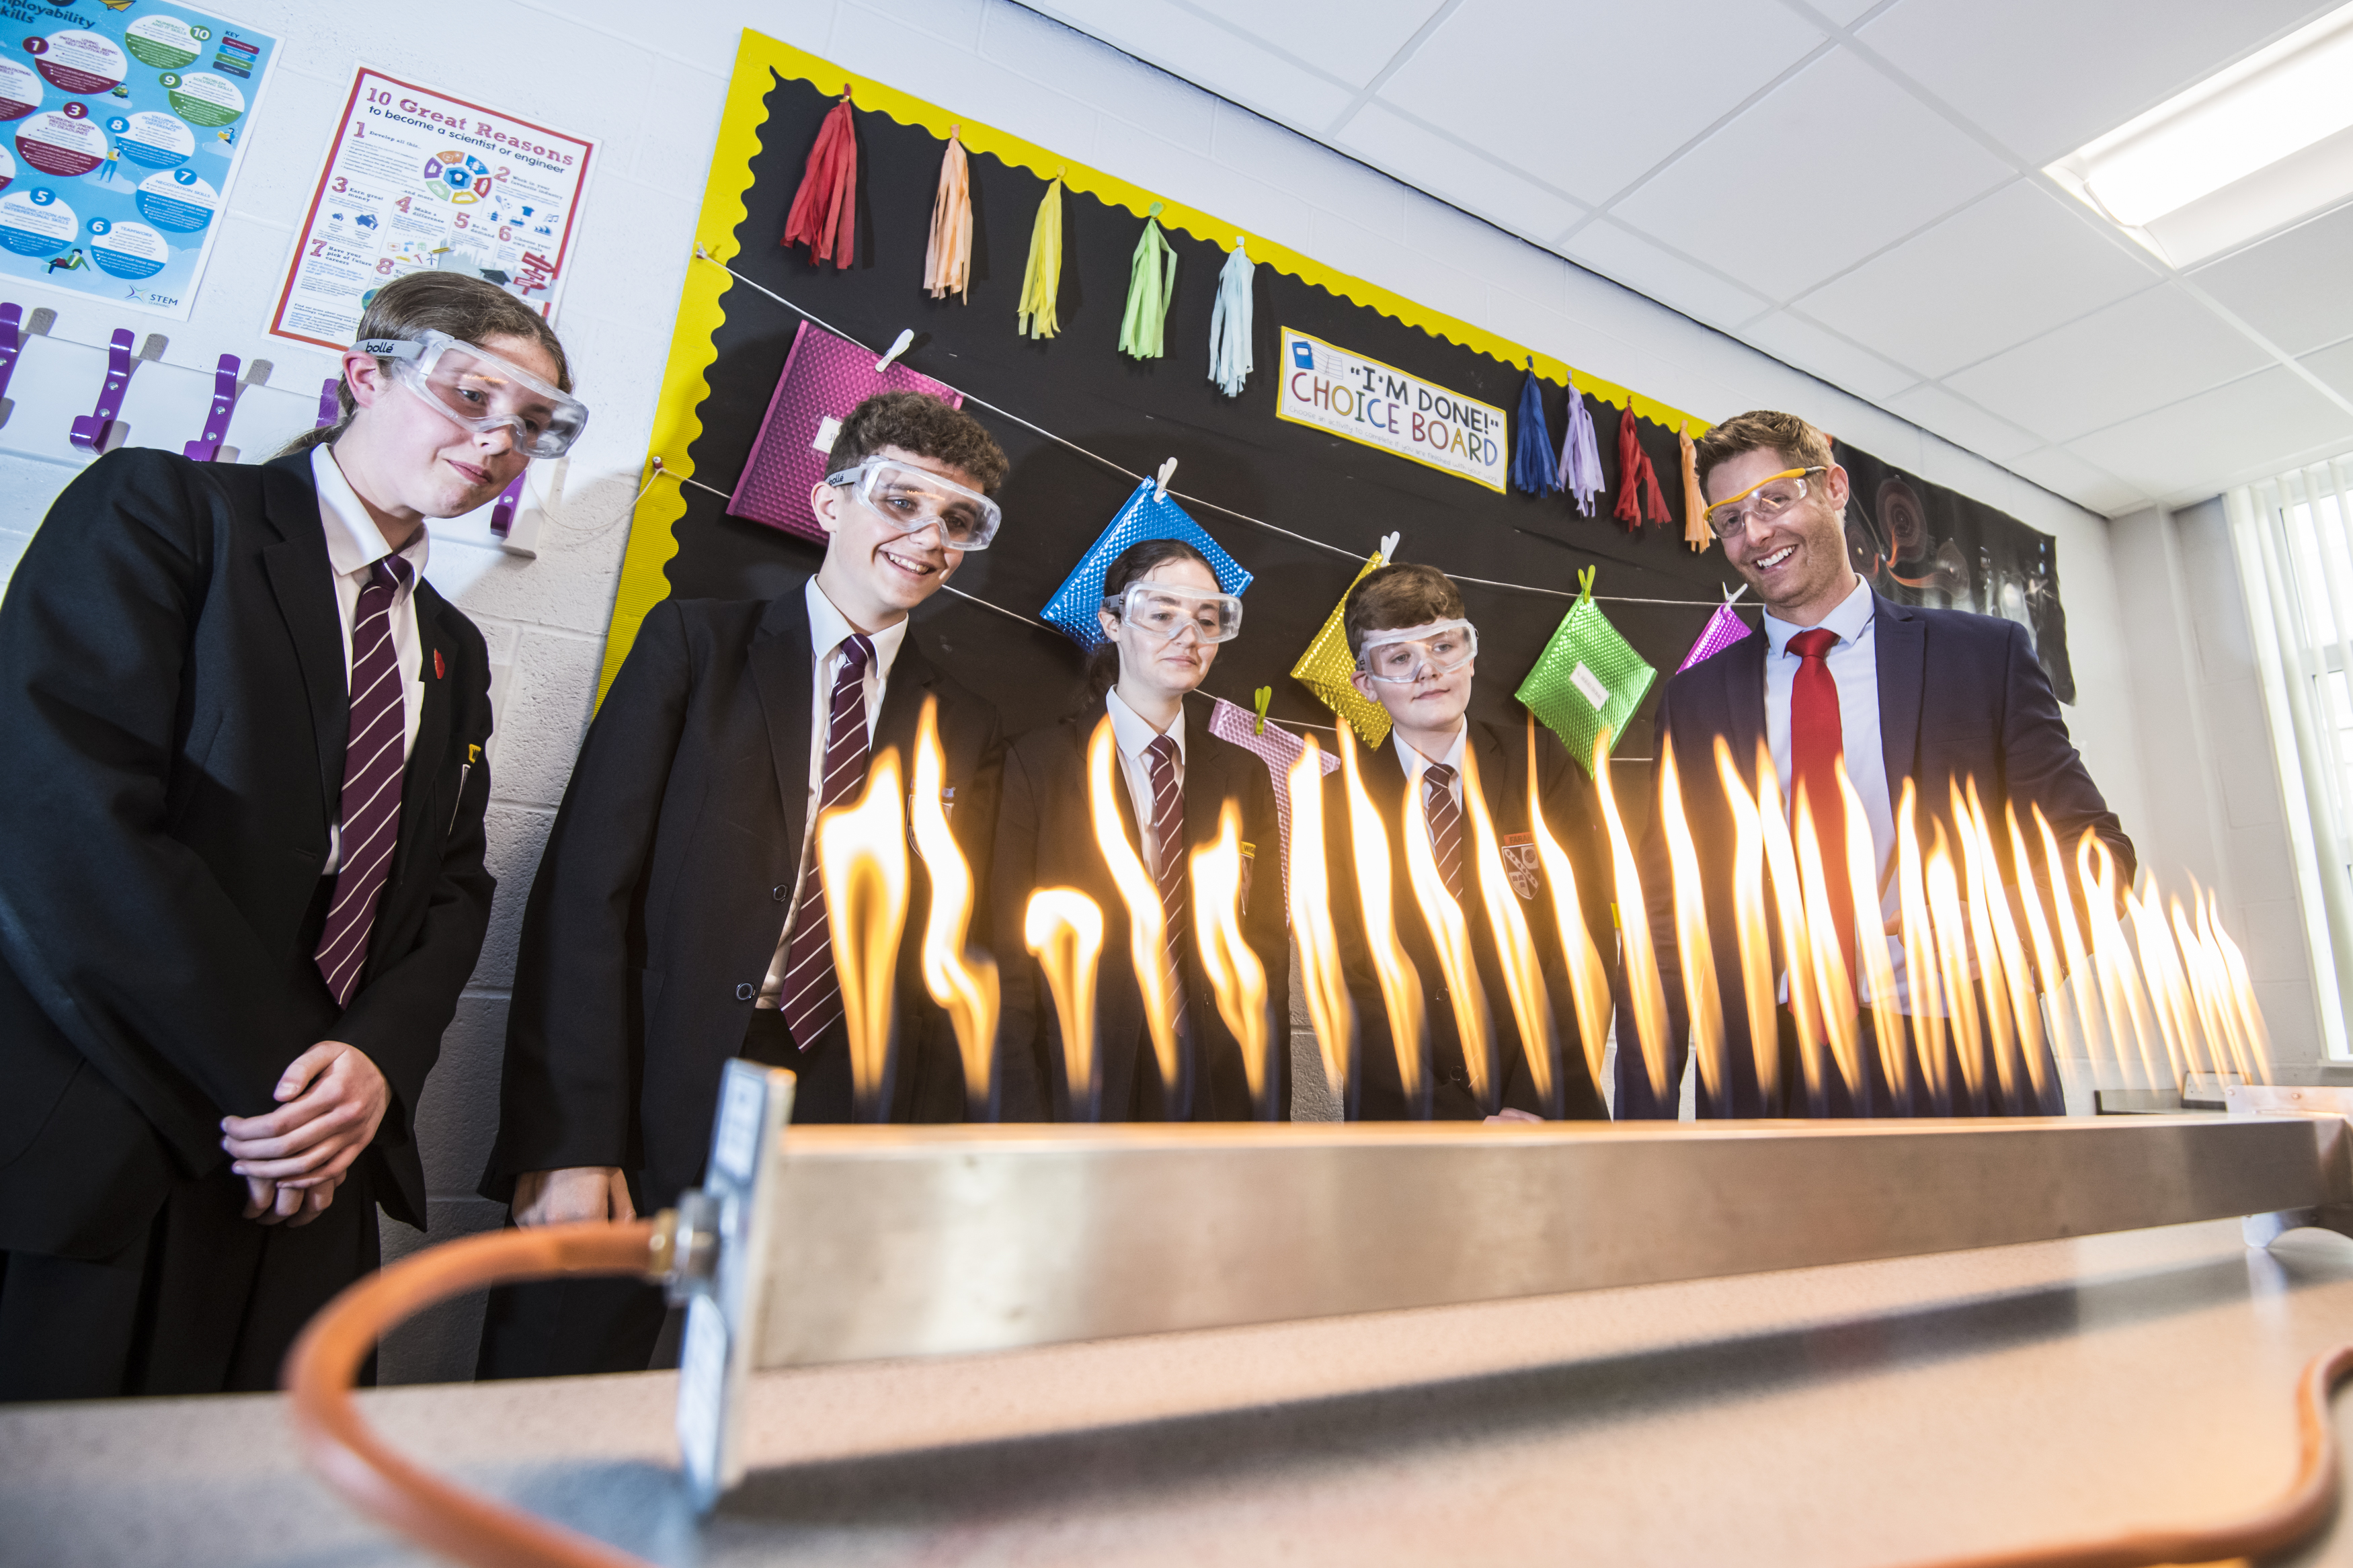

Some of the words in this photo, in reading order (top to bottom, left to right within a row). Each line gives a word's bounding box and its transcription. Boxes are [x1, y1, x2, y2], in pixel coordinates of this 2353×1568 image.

[156, 19, 184, 30] NUMERACY
[194, 28, 209, 39] 10
[30, 40, 40, 52] 1
[59, 36, 87, 46] INITIATIVE
[66, 41, 109, 56] SELF-MOTIVATED
[164, 75, 175, 85] 9
[194, 77, 216, 87] SOLVING
[202, 77, 226, 85] PROBLEM
[69, 106, 81, 116] 3
[47, 115, 73, 124] WORKING
[50, 119, 75, 128] PRESSURE
[112, 120, 123, 130] 8
[143, 116, 169, 126] DIVERSITY
[152, 115, 175, 124] VALUING
[58, 125, 87, 136] DEADLINES
[145, 121, 175, 132] DIFFERENCE
[354, 122, 364, 138] 1
[367, 88, 391, 106] 10
[400, 99, 466, 130] Great
[476, 123, 572, 165] Reasons
[370, 131, 395, 141] Develop
[370, 106, 381, 115] to
[385, 110, 434, 130] become
[449, 132, 495, 150] scientist
[515, 153, 564, 173] engineer
[180, 171, 191, 181] 7
[493, 167, 510, 183] 2
[156, 180, 193, 192] NEGOTIATION
[332, 177, 348, 193] 3
[511, 181, 536, 191] favourite
[539, 190, 563, 200] industry
[36, 191, 48, 202] 5
[348, 194, 370, 202] money
[5, 202, 56, 217] COMMUNICATION
[396, 196, 411, 213] 4
[4, 206, 48, 220] INTERPERSONAL
[413, 212, 444, 223] difference
[454, 212, 470, 229] 5
[93, 221, 104, 232] 6
[121, 226, 152, 237] TEAMWORK
[471, 229, 494, 238] demand
[499, 226, 512, 241] 6
[514, 237, 535, 245] Choose
[311, 239, 327, 257] 7
[325, 257, 349, 265] careers
[352, 258, 372, 266] future
[376, 258, 394, 274] 8
[151, 294, 177, 305] STEM
[365, 341, 395, 354] bollé
[1291, 371, 1400, 435] CHOICE
[1412, 411, 1498, 466] BOARD
[1289, 405, 1316, 419] Choose
[1318, 414, 1326, 423] an
[1328, 418, 1353, 434] activity
[1355, 425, 1363, 435] to
[1365, 429, 1393, 446] complete
[1401, 442, 1414, 454] you
[1415, 448, 1426, 458] are
[1427, 451, 1451, 466] finished
[1452, 460, 1466, 471] with
[1468, 464, 1482, 477] your
[1484, 470, 1499, 483] work
[829, 473, 844, 485] bollé
